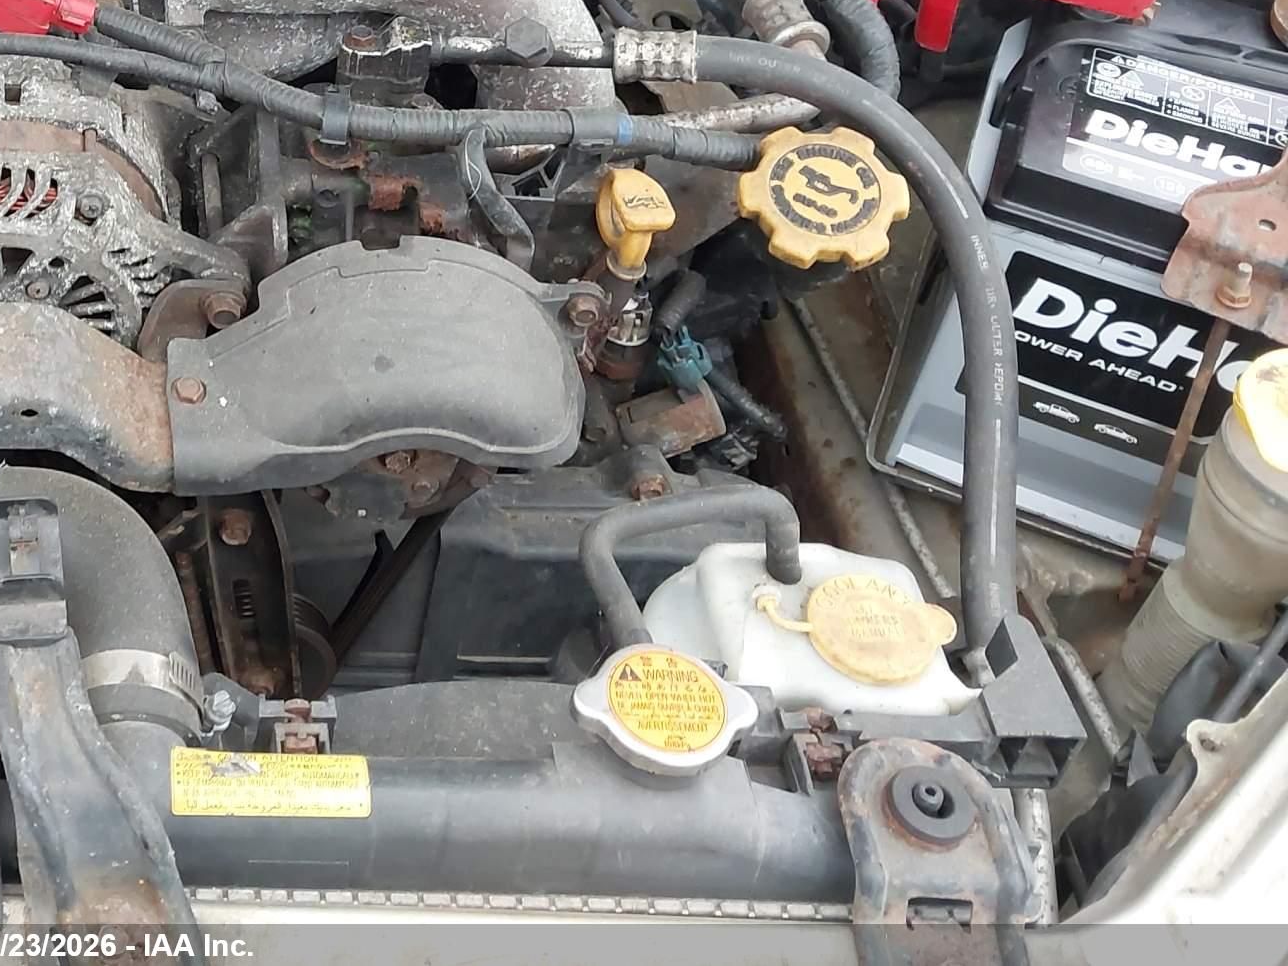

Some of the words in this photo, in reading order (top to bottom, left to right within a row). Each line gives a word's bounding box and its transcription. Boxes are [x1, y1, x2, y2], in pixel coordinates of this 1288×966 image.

[1014, 330, 1084, 362] OWER
[1088, 358, 1178, 394] AHEAD
[642, 669, 699, 683] WARNING
[645, 692, 668, 702] OPEN
[637, 721, 709, 733] AVERTISSEMENT
[261, 754, 319, 764] ATTENTION
